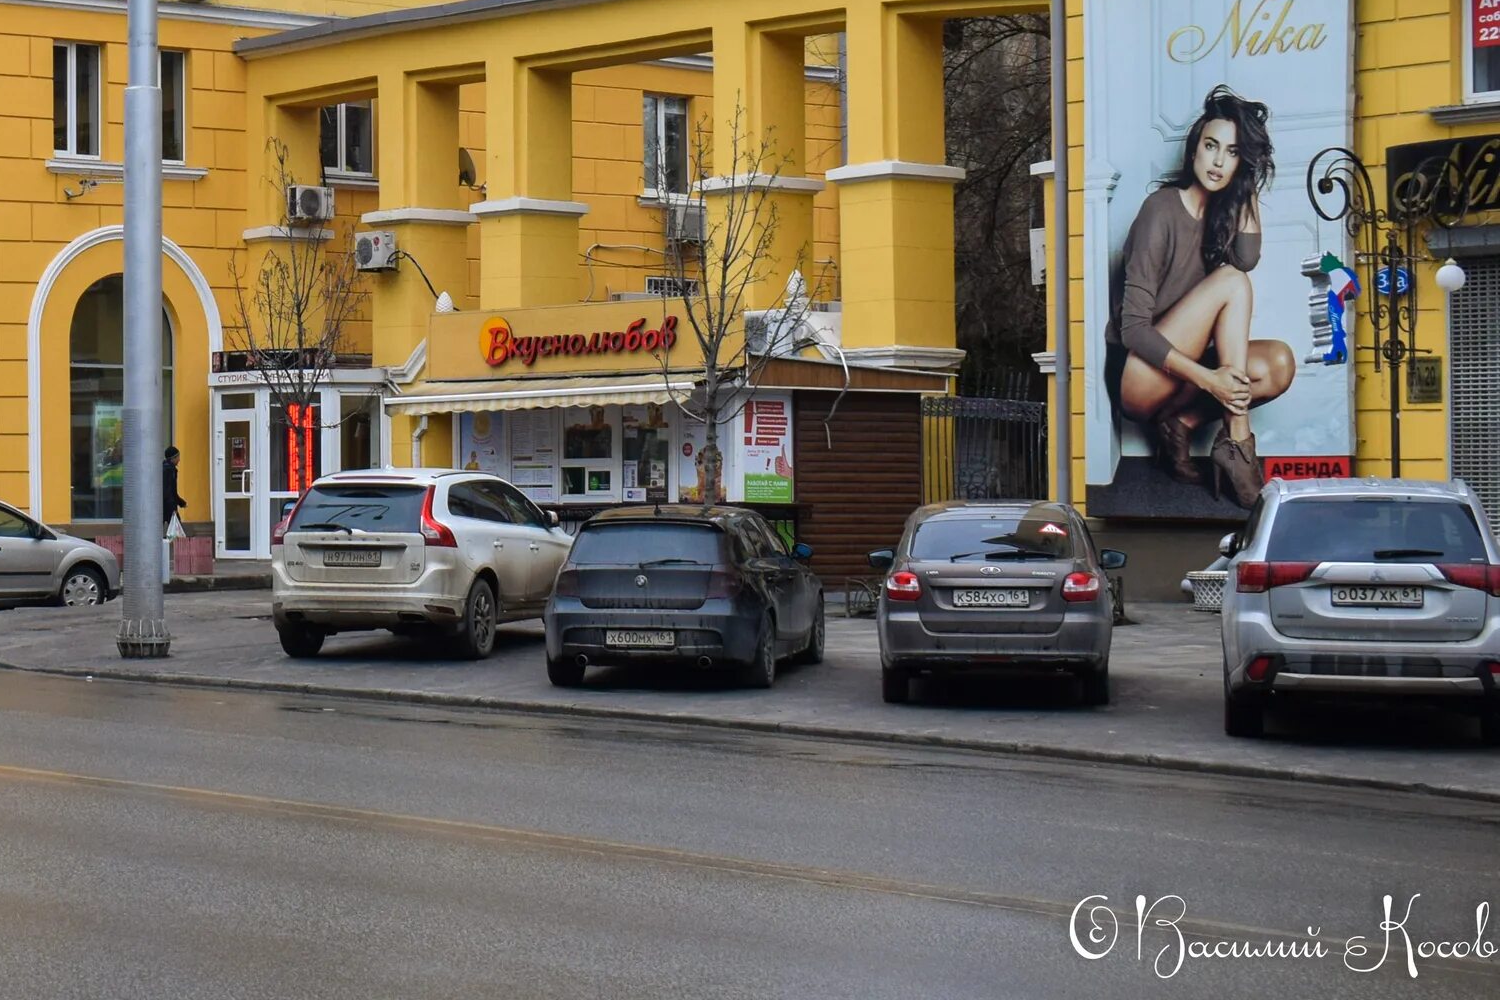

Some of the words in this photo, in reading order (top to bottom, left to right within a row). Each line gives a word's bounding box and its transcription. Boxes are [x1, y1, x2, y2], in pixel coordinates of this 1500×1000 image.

[1378, 273, 1407, 289] 3а
[486, 315, 679, 367] Вкуснолюбов
[218, 373, 248, 384] СТУДИЯ
[1270, 462, 1343, 478] АРЕНДА
[957, 590, 1006, 603] К584ХО
[1008, 590, 1027, 600] 161
[1337, 587, 1399, 602] О037ХК
[1402, 587, 1418, 599] 61
[610, 631, 652, 644] Х600МХ
